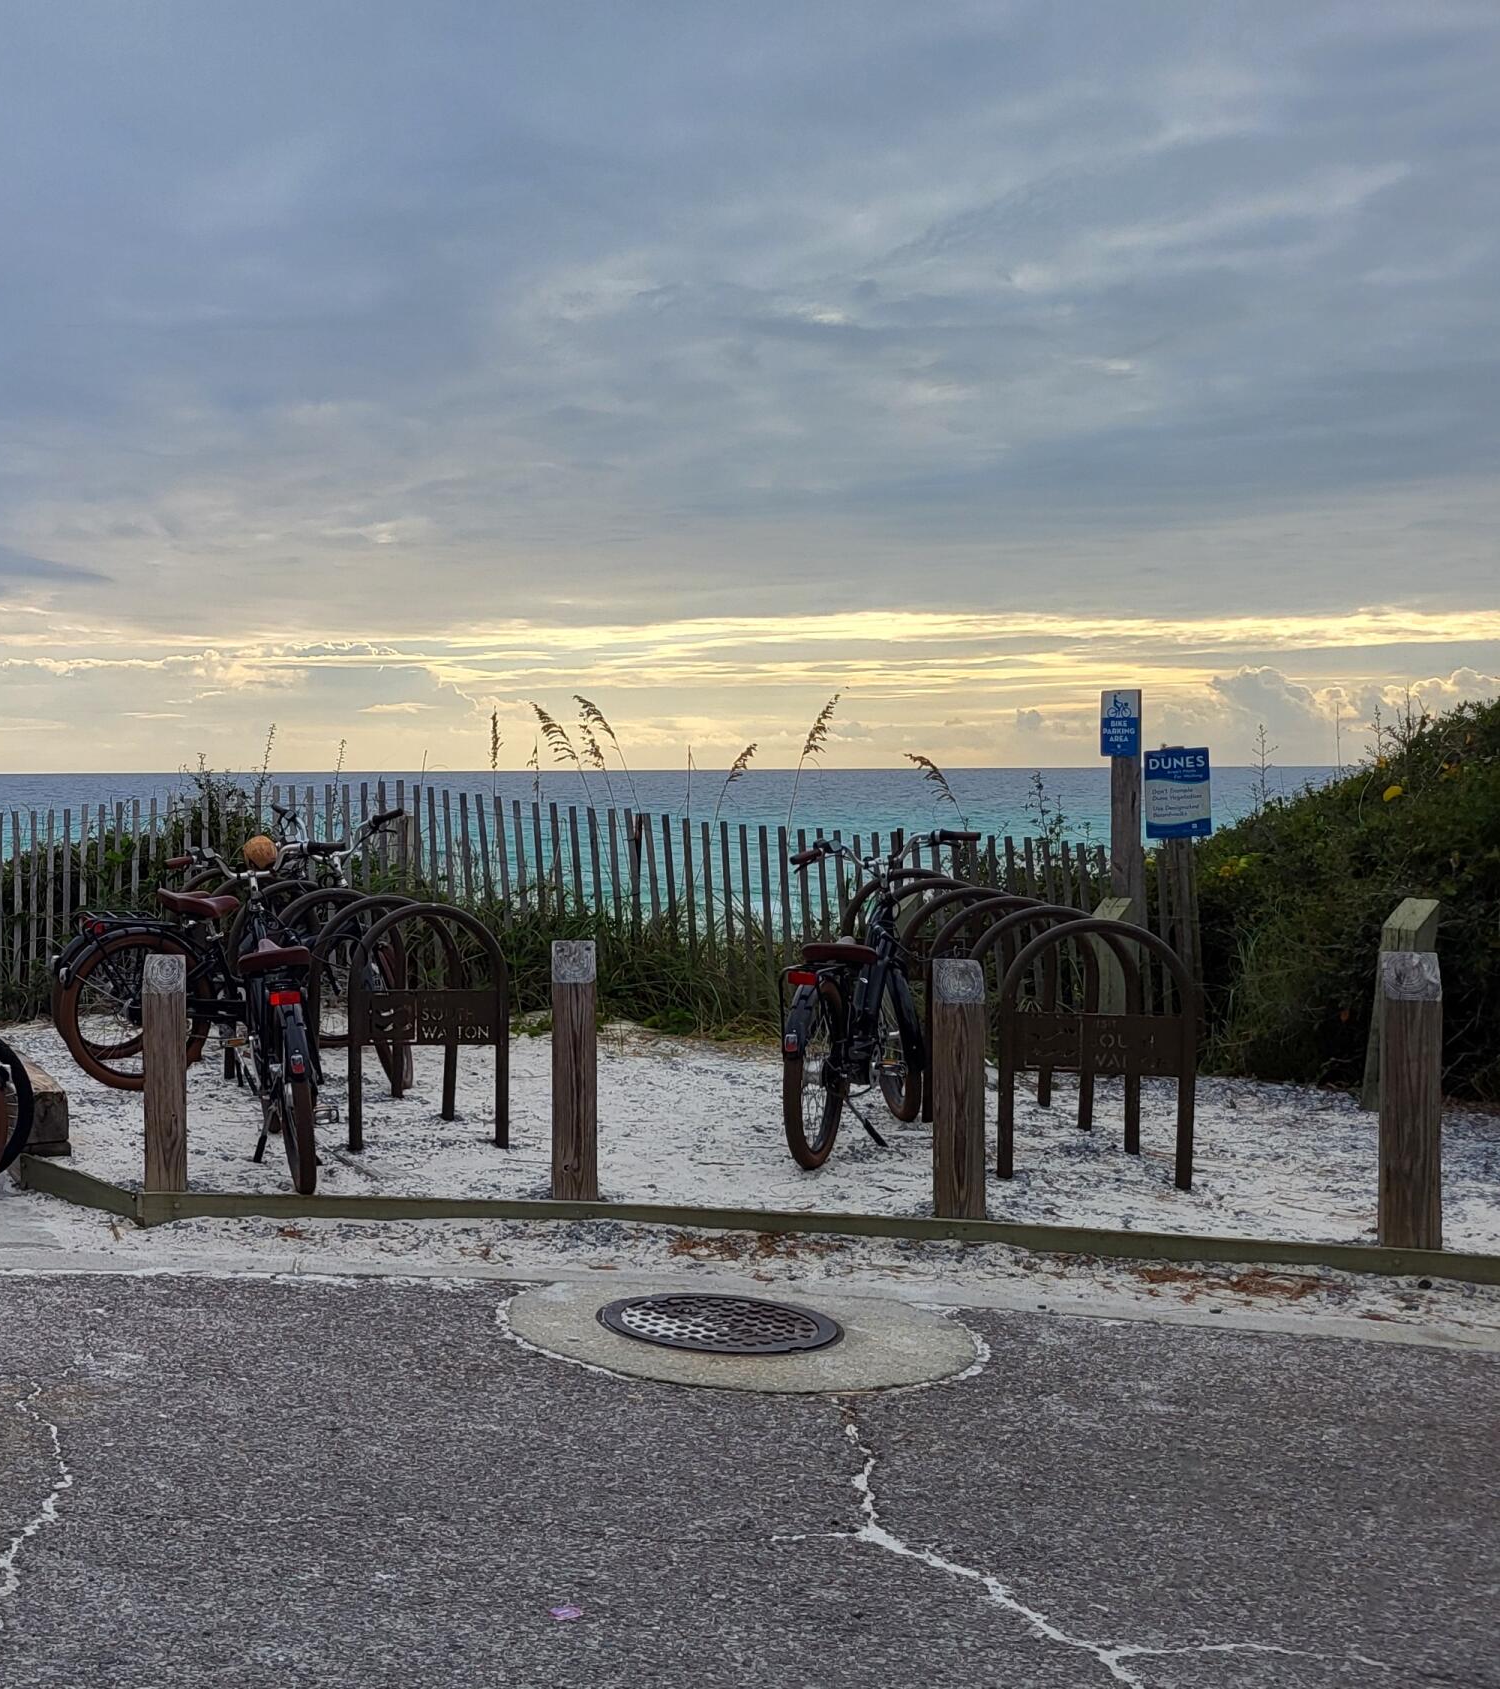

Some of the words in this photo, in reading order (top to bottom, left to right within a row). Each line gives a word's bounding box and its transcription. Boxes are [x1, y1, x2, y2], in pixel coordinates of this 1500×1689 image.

[1102, 727, 1136, 735] PARKING
[1148, 755, 1205, 770] DUNES
[421, 1026, 490, 1039] WATON
